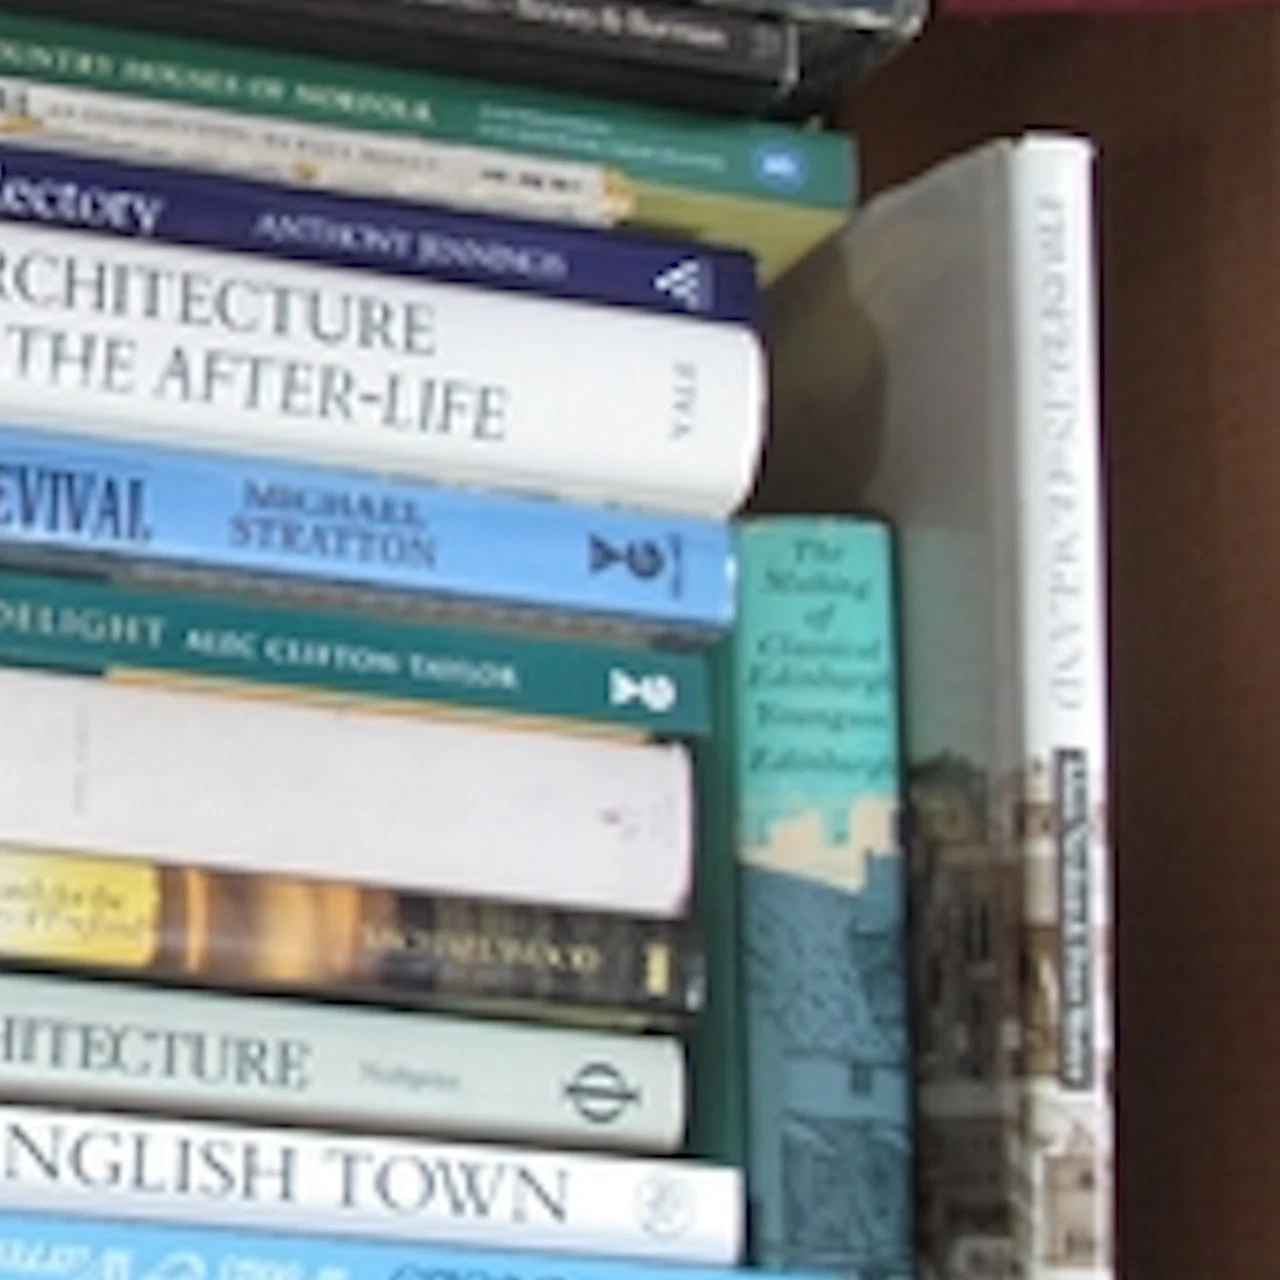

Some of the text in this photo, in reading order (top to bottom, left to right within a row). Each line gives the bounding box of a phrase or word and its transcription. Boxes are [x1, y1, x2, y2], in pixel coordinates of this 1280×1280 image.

[121, 57, 238, 94] HOUSES
[246, 74, 287, 101] OF
[295, 78, 432, 122] NORFOLK
[252, 213, 568, 280] ANTHONY JENNINGS
[5, 324, 137, 395] THE
[151, 347, 511, 442] AFTER-LIFE
[243, 477, 426, 531] MICHAEL
[229, 517, 439, 569] STRATTON
[324, 1145, 574, 1225] TOWN
